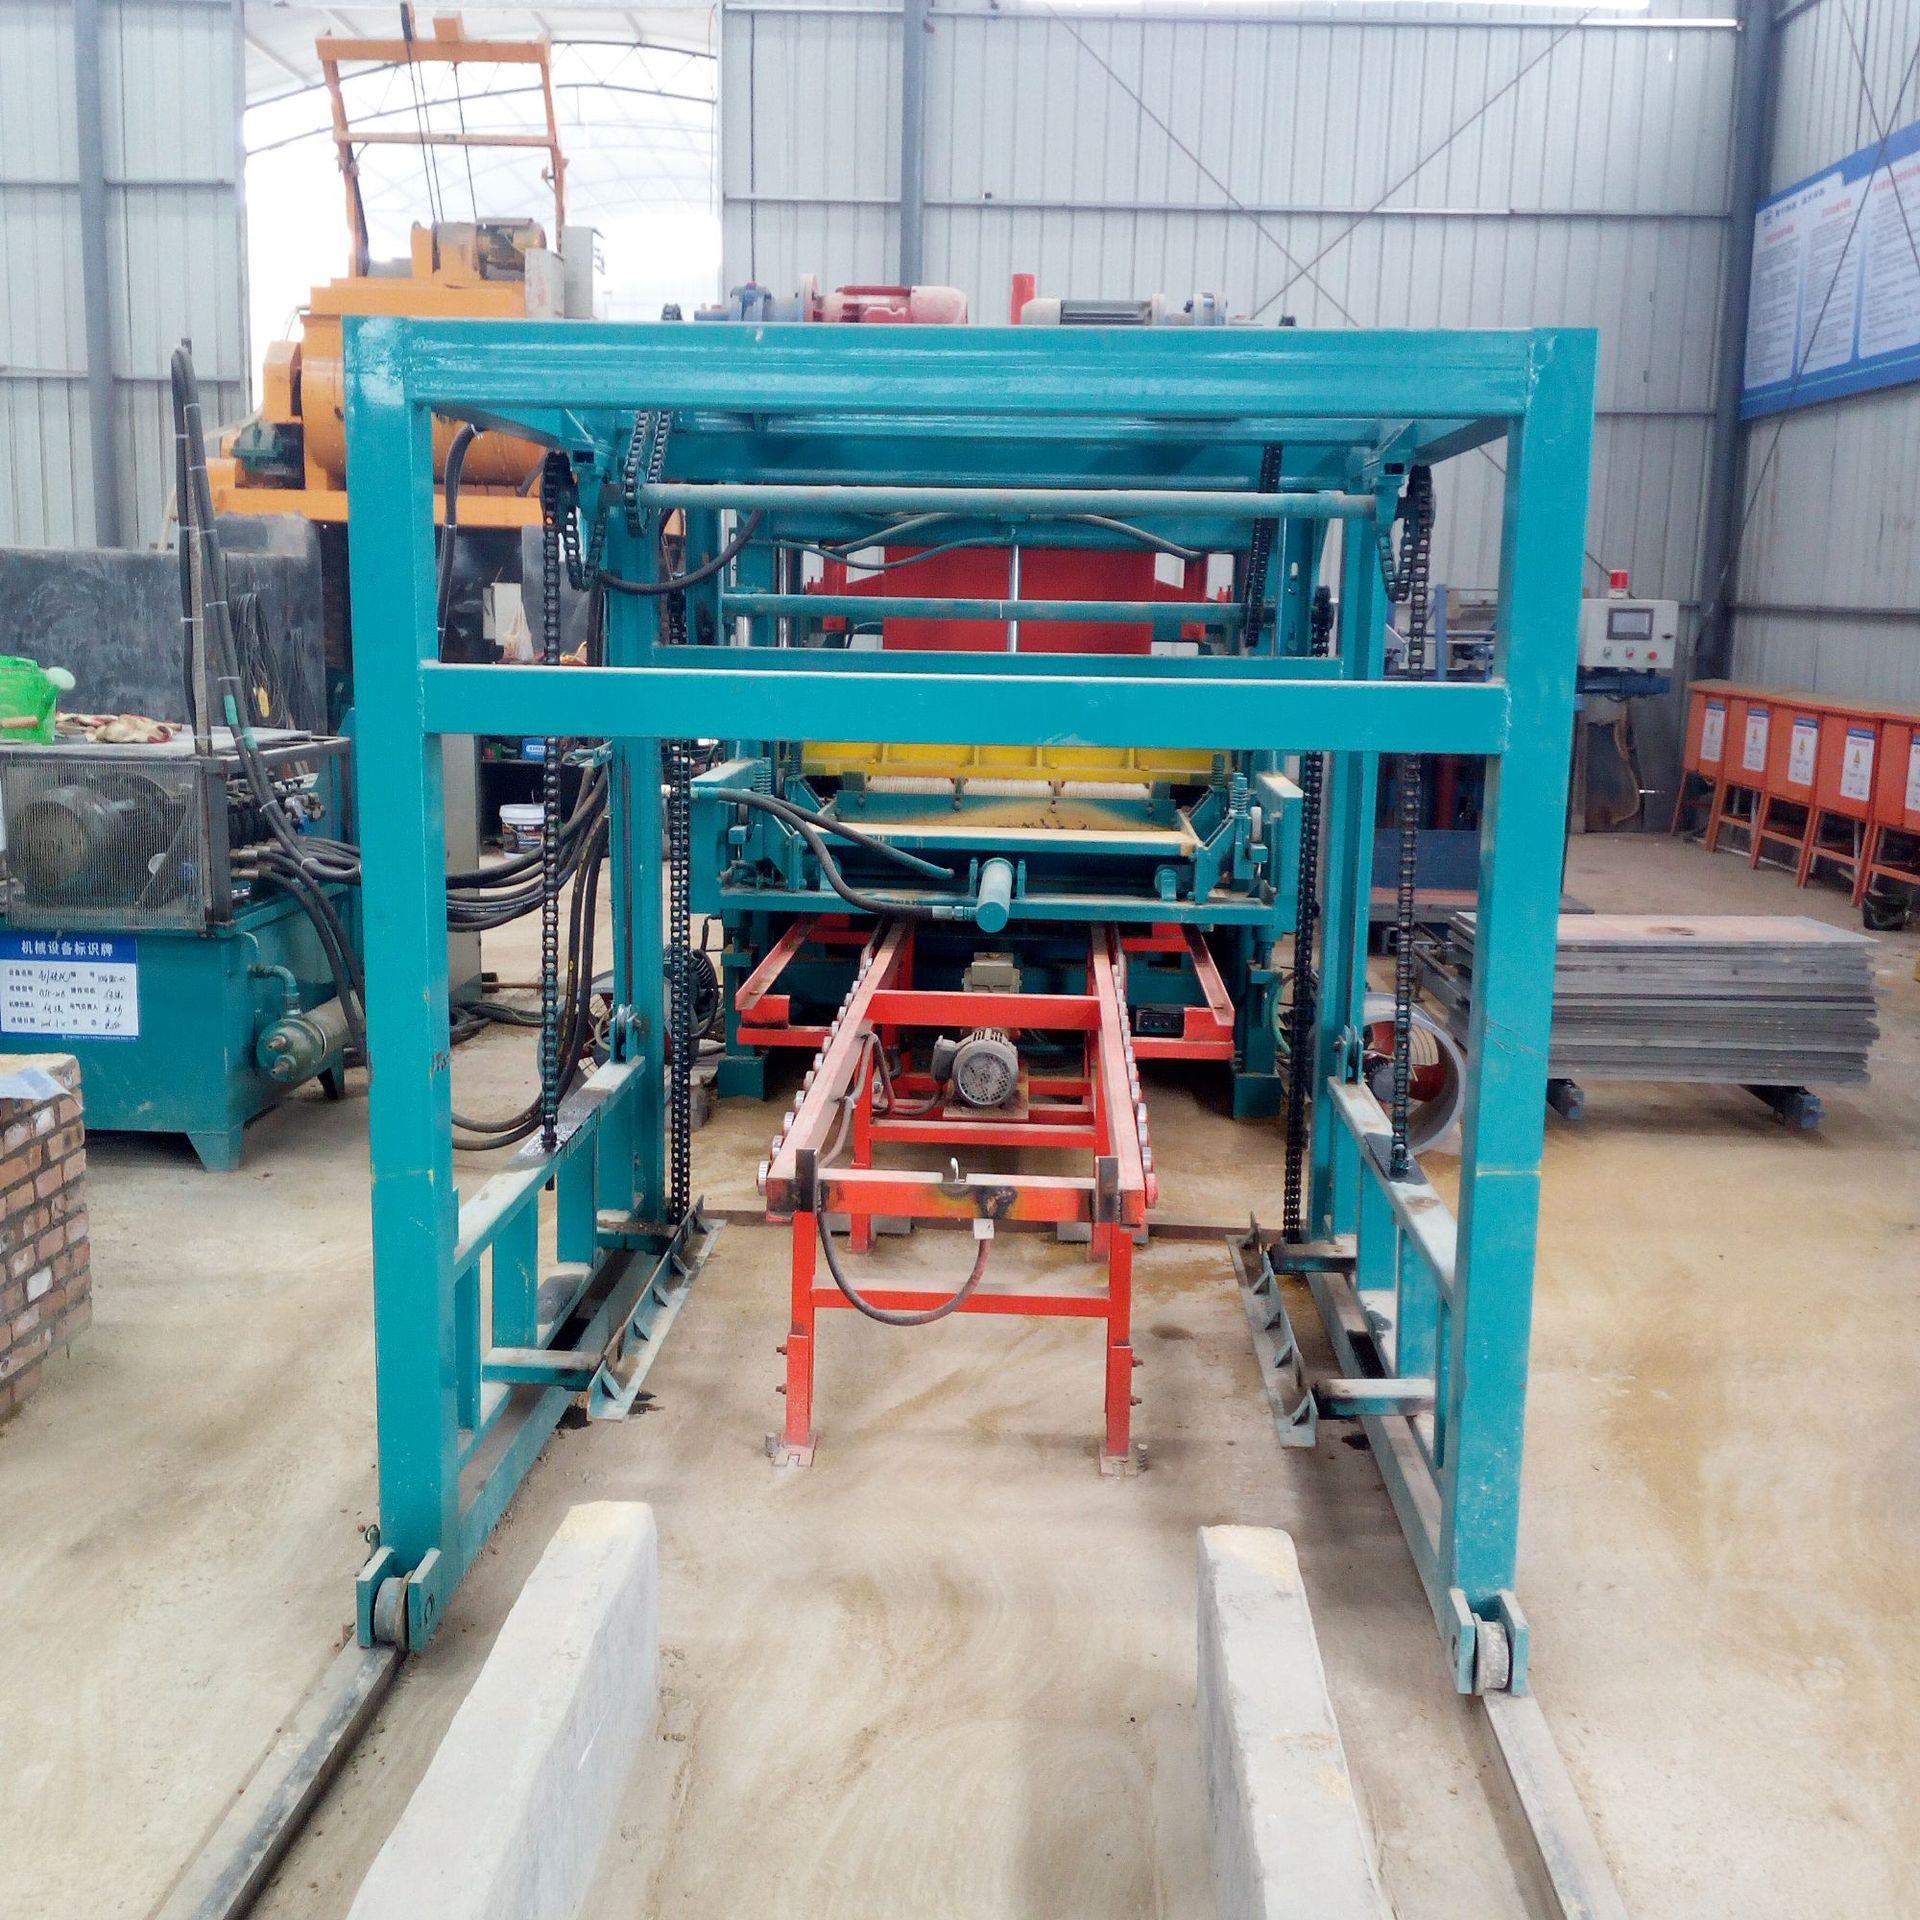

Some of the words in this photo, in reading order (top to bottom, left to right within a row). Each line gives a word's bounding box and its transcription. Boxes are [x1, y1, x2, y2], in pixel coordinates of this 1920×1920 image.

[21, 939, 114, 957] 机械设备标识牌
